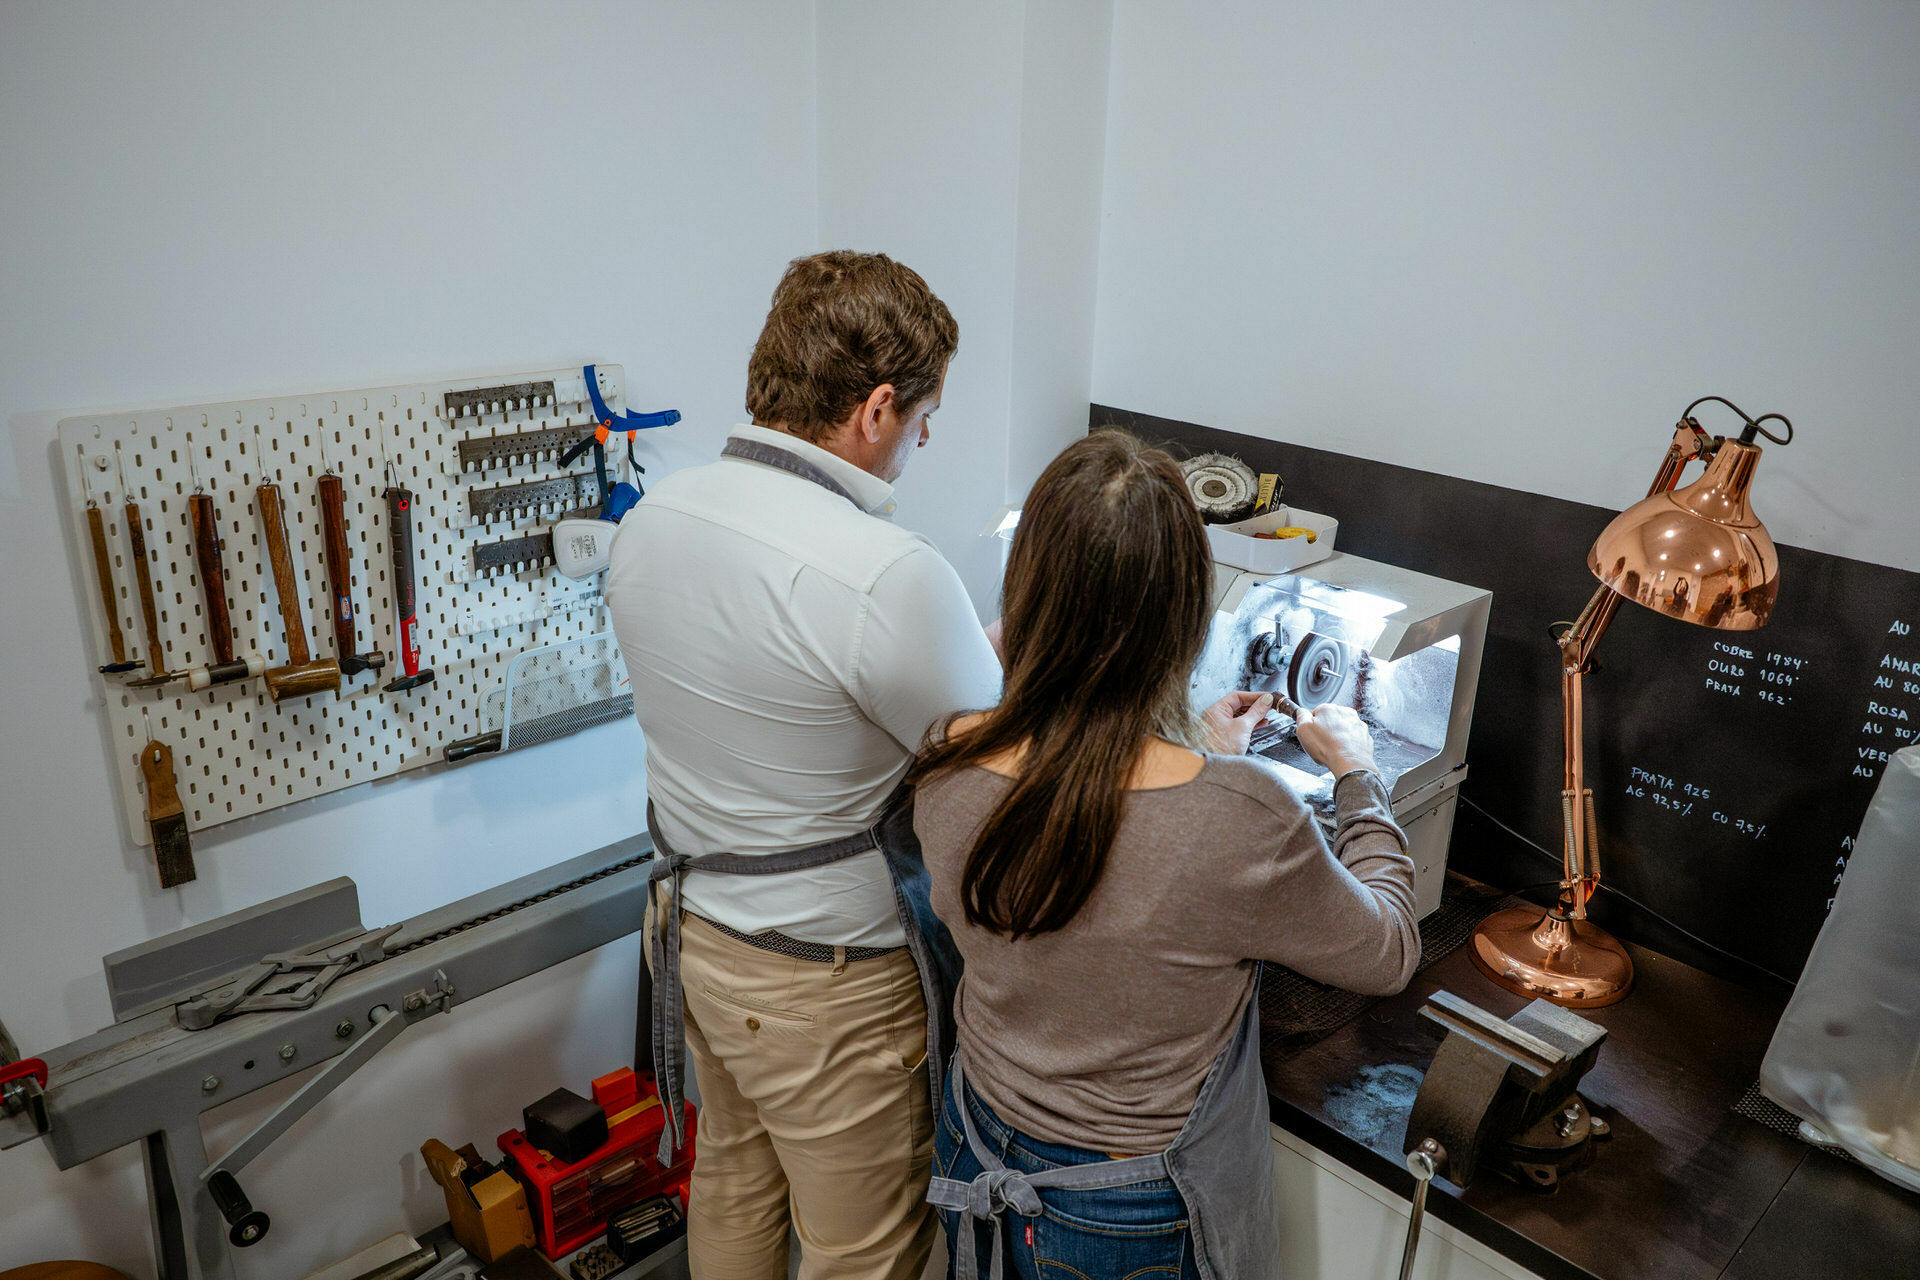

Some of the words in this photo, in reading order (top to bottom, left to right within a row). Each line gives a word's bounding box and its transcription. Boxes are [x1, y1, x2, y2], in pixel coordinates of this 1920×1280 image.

[1888, 620, 1910, 635] AU
[1714, 641, 1754, 660] COBRE
[1708, 659, 1745, 677] OURO
[1706, 678, 1740, 696] PRATA
[1873, 675, 1894, 688] AU
[1903, 681, 1920, 700] 80
[1867, 701, 1909, 721] ROSA
[1862, 721, 1883, 734] AU
[1852, 764, 1874, 778] AU
[1631, 766, 1675, 790] PRATA
[1683, 783, 1711, 799] 925
[1625, 785, 1645, 797] AG
[1712, 811, 1728, 824] CU
